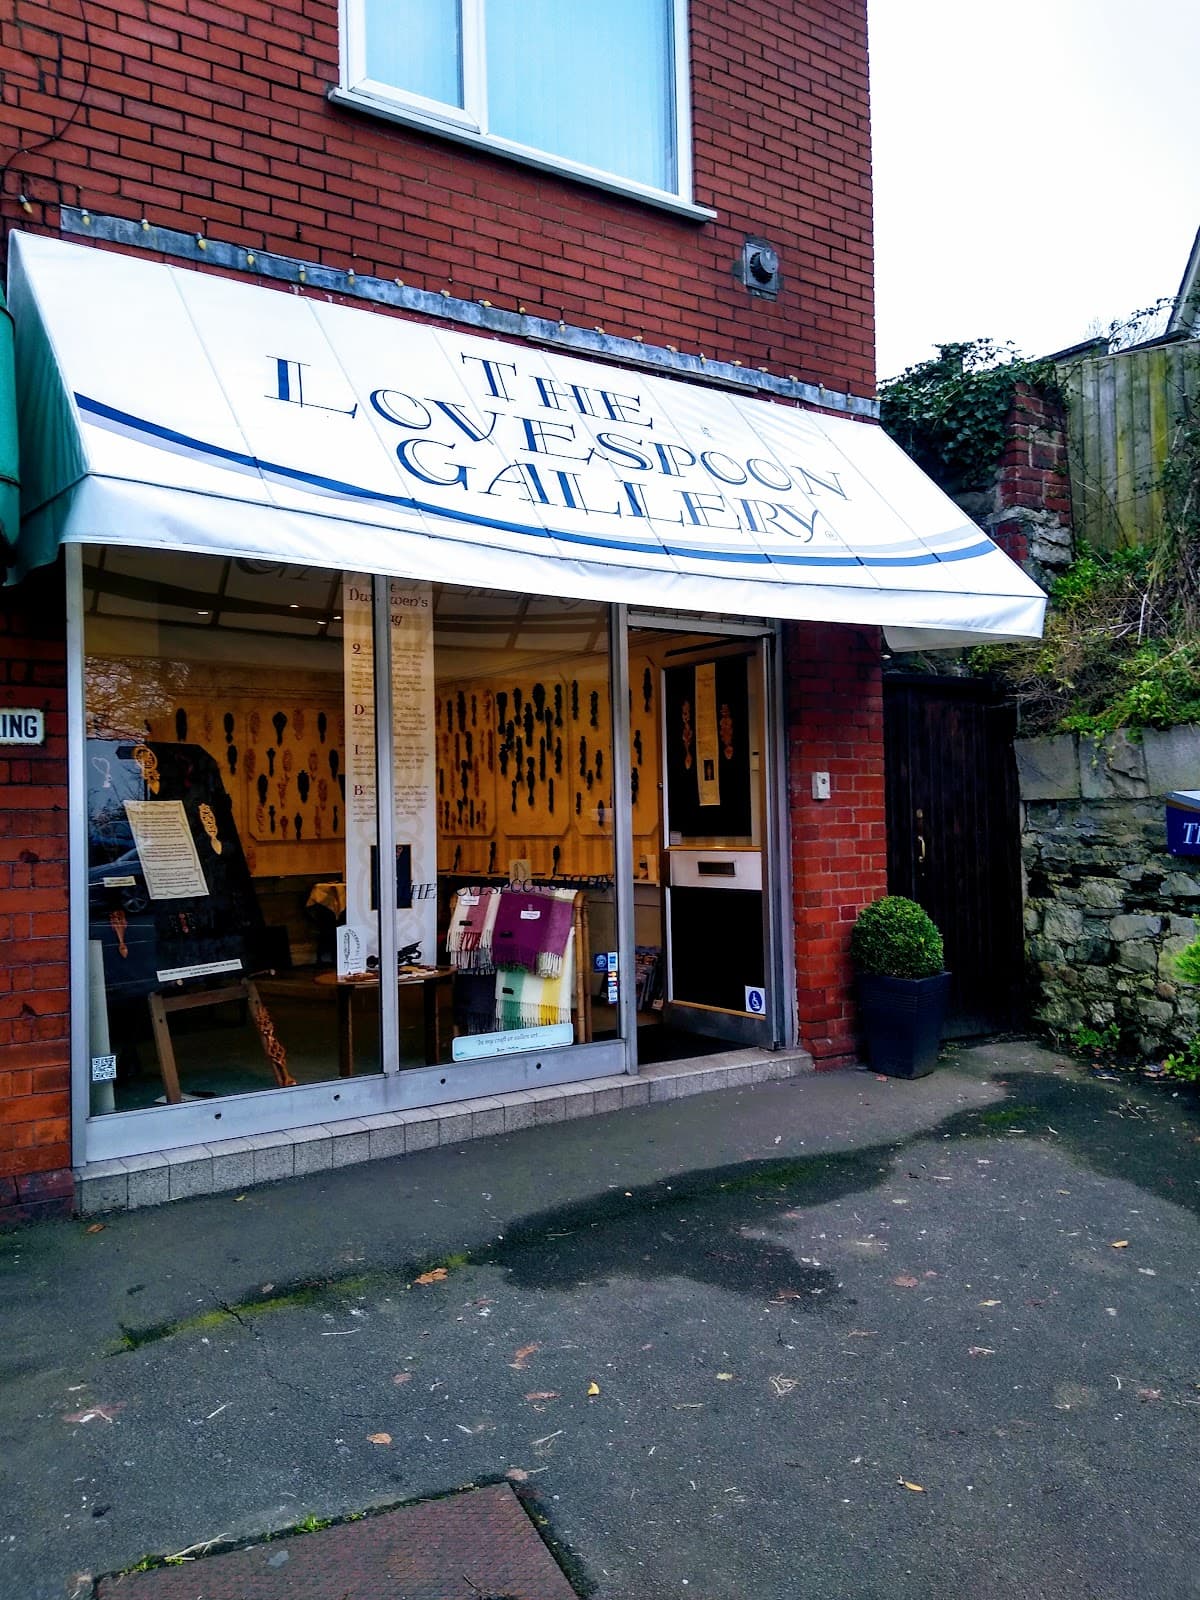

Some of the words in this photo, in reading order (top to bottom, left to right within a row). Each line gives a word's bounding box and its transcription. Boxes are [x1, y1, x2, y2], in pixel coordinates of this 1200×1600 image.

[264, 355, 851, 501] LOVESPOON
[461, 352, 653, 430] THE
[396, 438, 819, 542] GALLERY
[0, 714, 38, 738] ING
